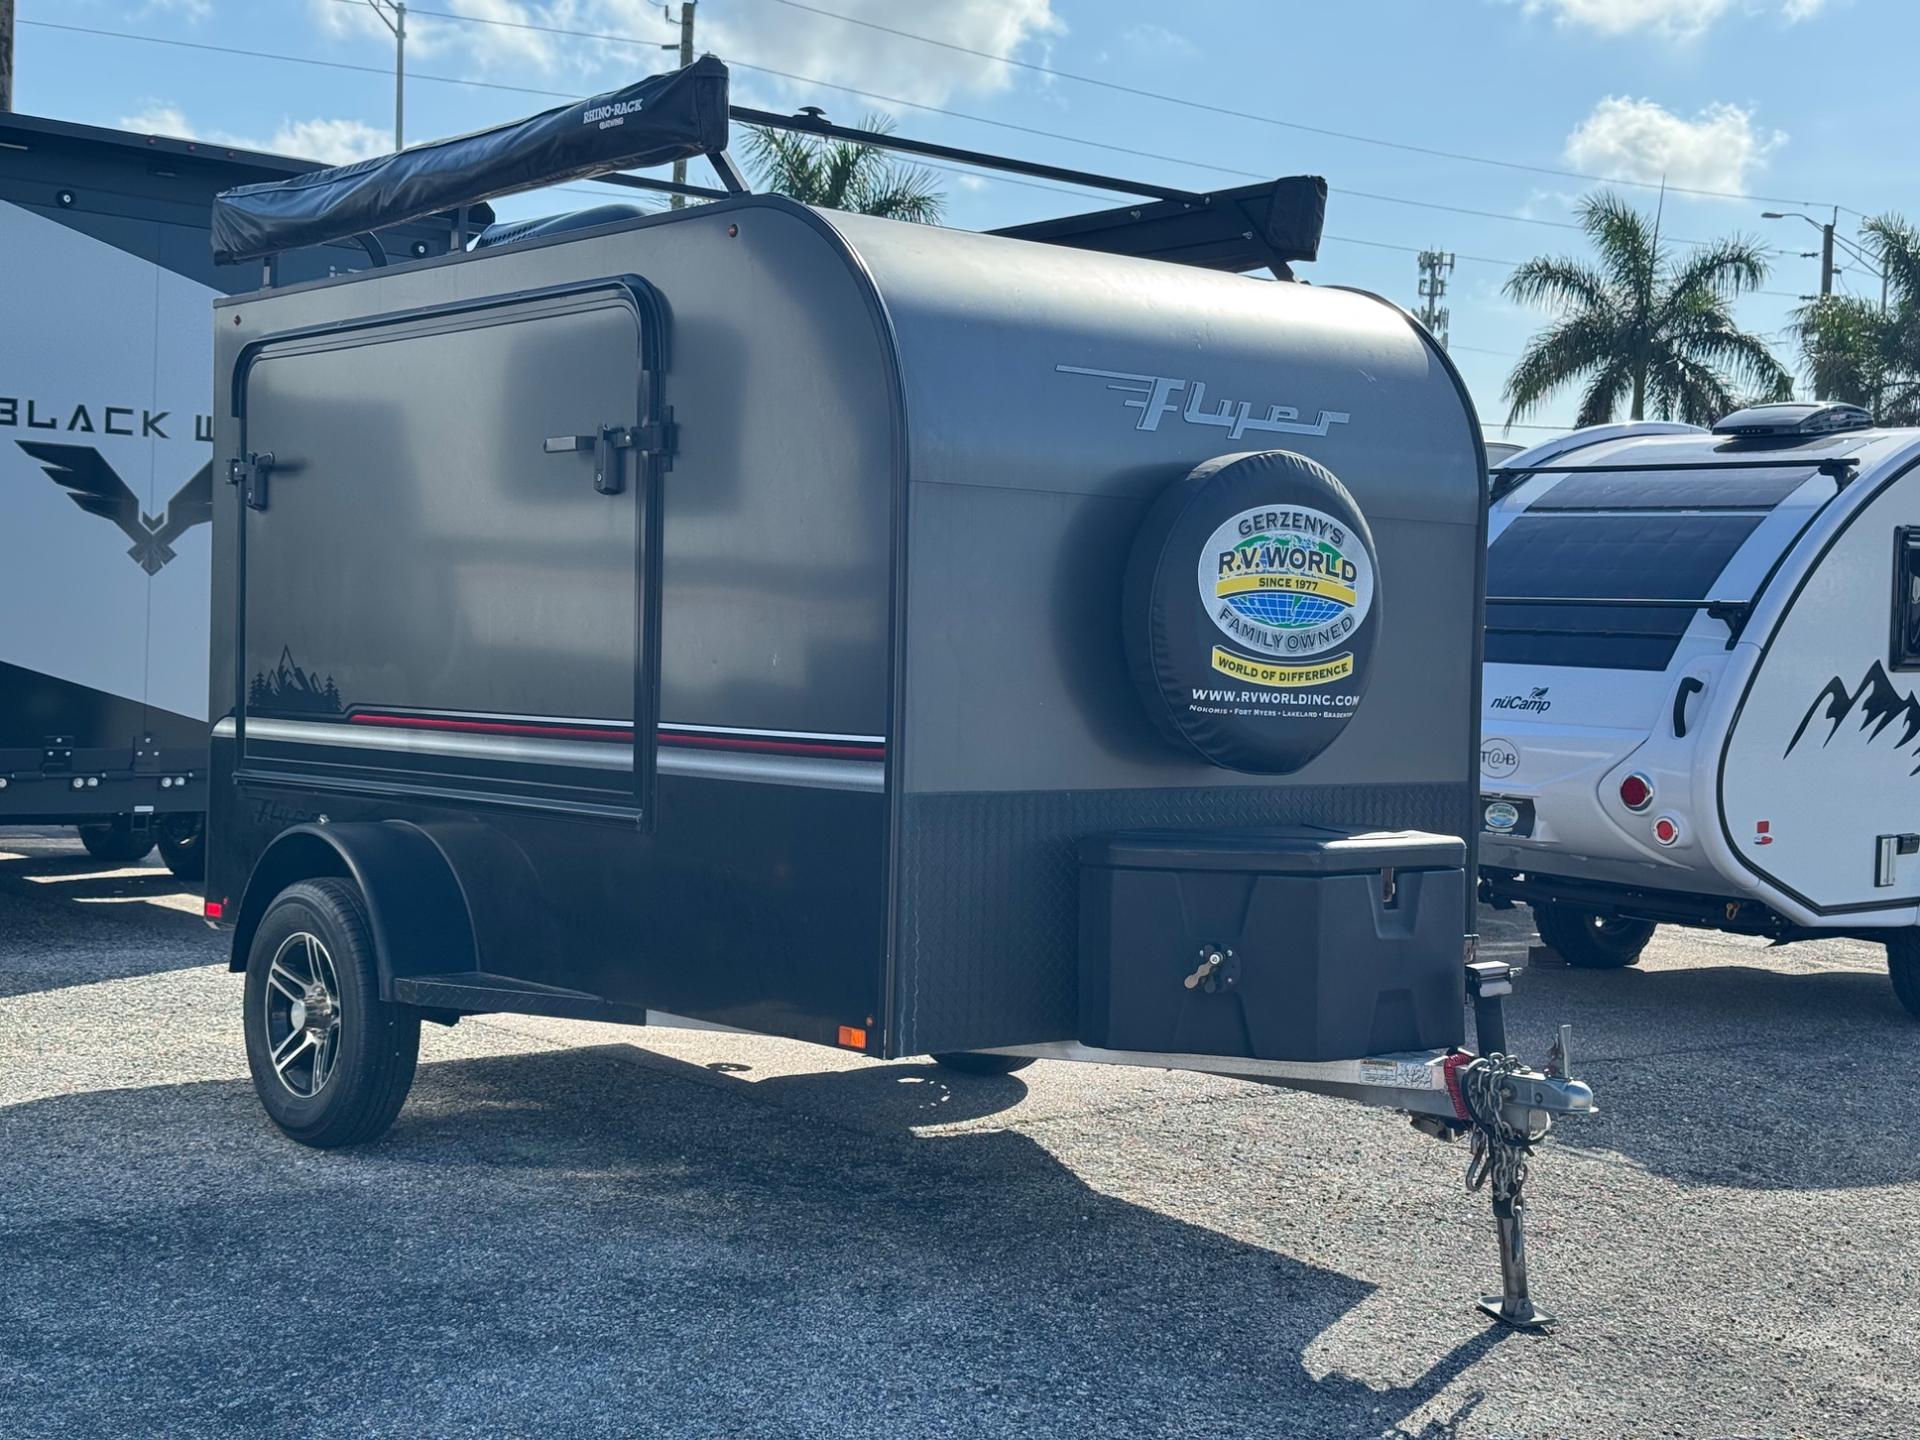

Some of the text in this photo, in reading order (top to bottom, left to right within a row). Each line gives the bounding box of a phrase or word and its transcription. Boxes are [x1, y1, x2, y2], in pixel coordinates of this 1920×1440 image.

[583, 99, 643, 124] RHINO-RACK
[1055, 364, 1350, 440] Flyer
[0, 397, 171, 439] BLACK
[1239, 512, 1344, 545] GERZENY'S
[1259, 577, 1319, 592] SINCE 1977
[1219, 607, 1352, 650] FAMILY OWNED
[1218, 656, 1349, 682] WORLD OF DIFFERENCE
[1192, 688, 1360, 705] WWW.RVWORLDINC.COM
[1491, 696, 1551, 714] nüCamp
[1481, 748, 1516, 769] T@B
